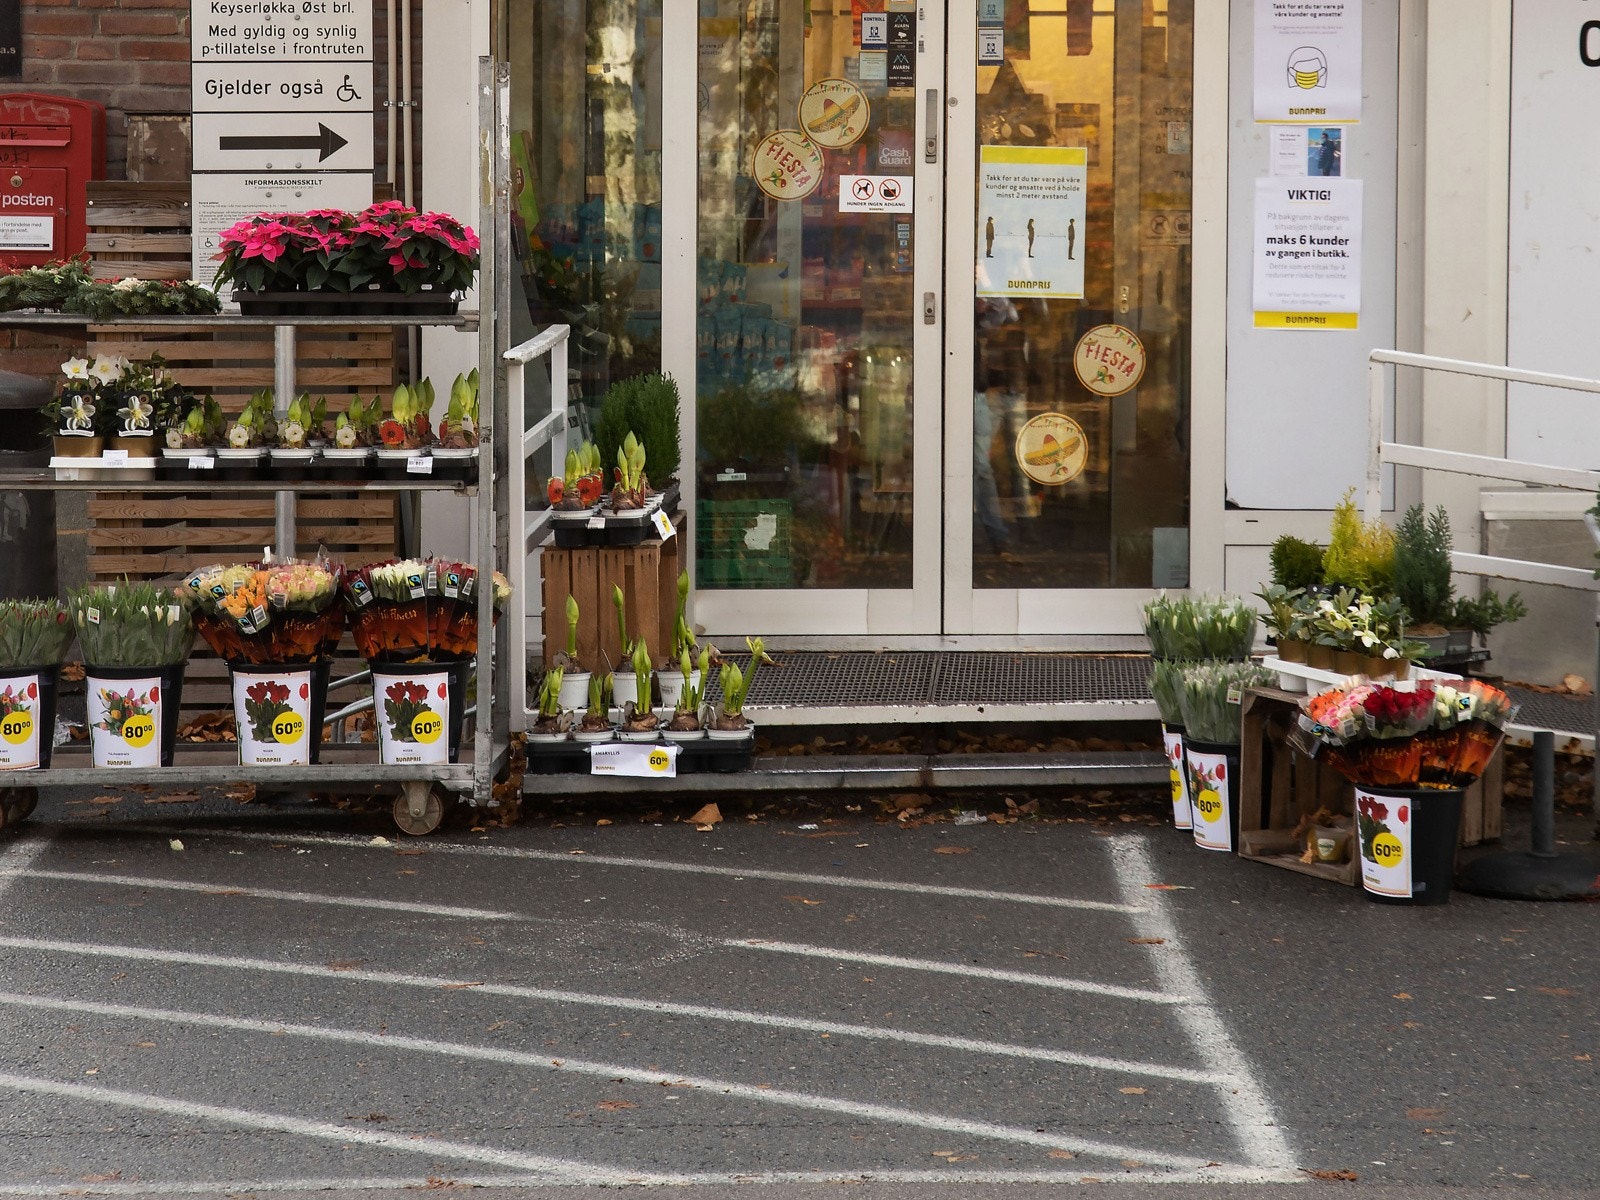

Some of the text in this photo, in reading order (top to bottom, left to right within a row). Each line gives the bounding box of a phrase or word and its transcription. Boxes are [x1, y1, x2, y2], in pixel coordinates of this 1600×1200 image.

[211, 1, 355, 16] Keyserløkka Øst brl.
[208, 25, 357, 39] Med gyldig og synlig
[202, 43, 276, 57] p-tillatelse
[293, 43, 364, 54] frontruten
[205, 78, 324, 99] Gjelder også
[881, 147, 909, 157] Cash
[766, 143, 812, 188] FIESTA
[879, 155, 911, 166] Guard
[1057, 176, 1065, 184] på
[2, 192, 54, 208] posten
[1287, 189, 1331, 201] VIKTIG!
[1266, 234, 1350, 246] maks 6 kunder
[1278, 250, 1311, 259] gangen
[1317, 249, 1350, 258] butikk.
[1007, 280, 1051, 289] BUNNPRIS
[1285, 316, 1327, 325] BUNNPRIS
[1085, 344, 1137, 377] FIESTA
